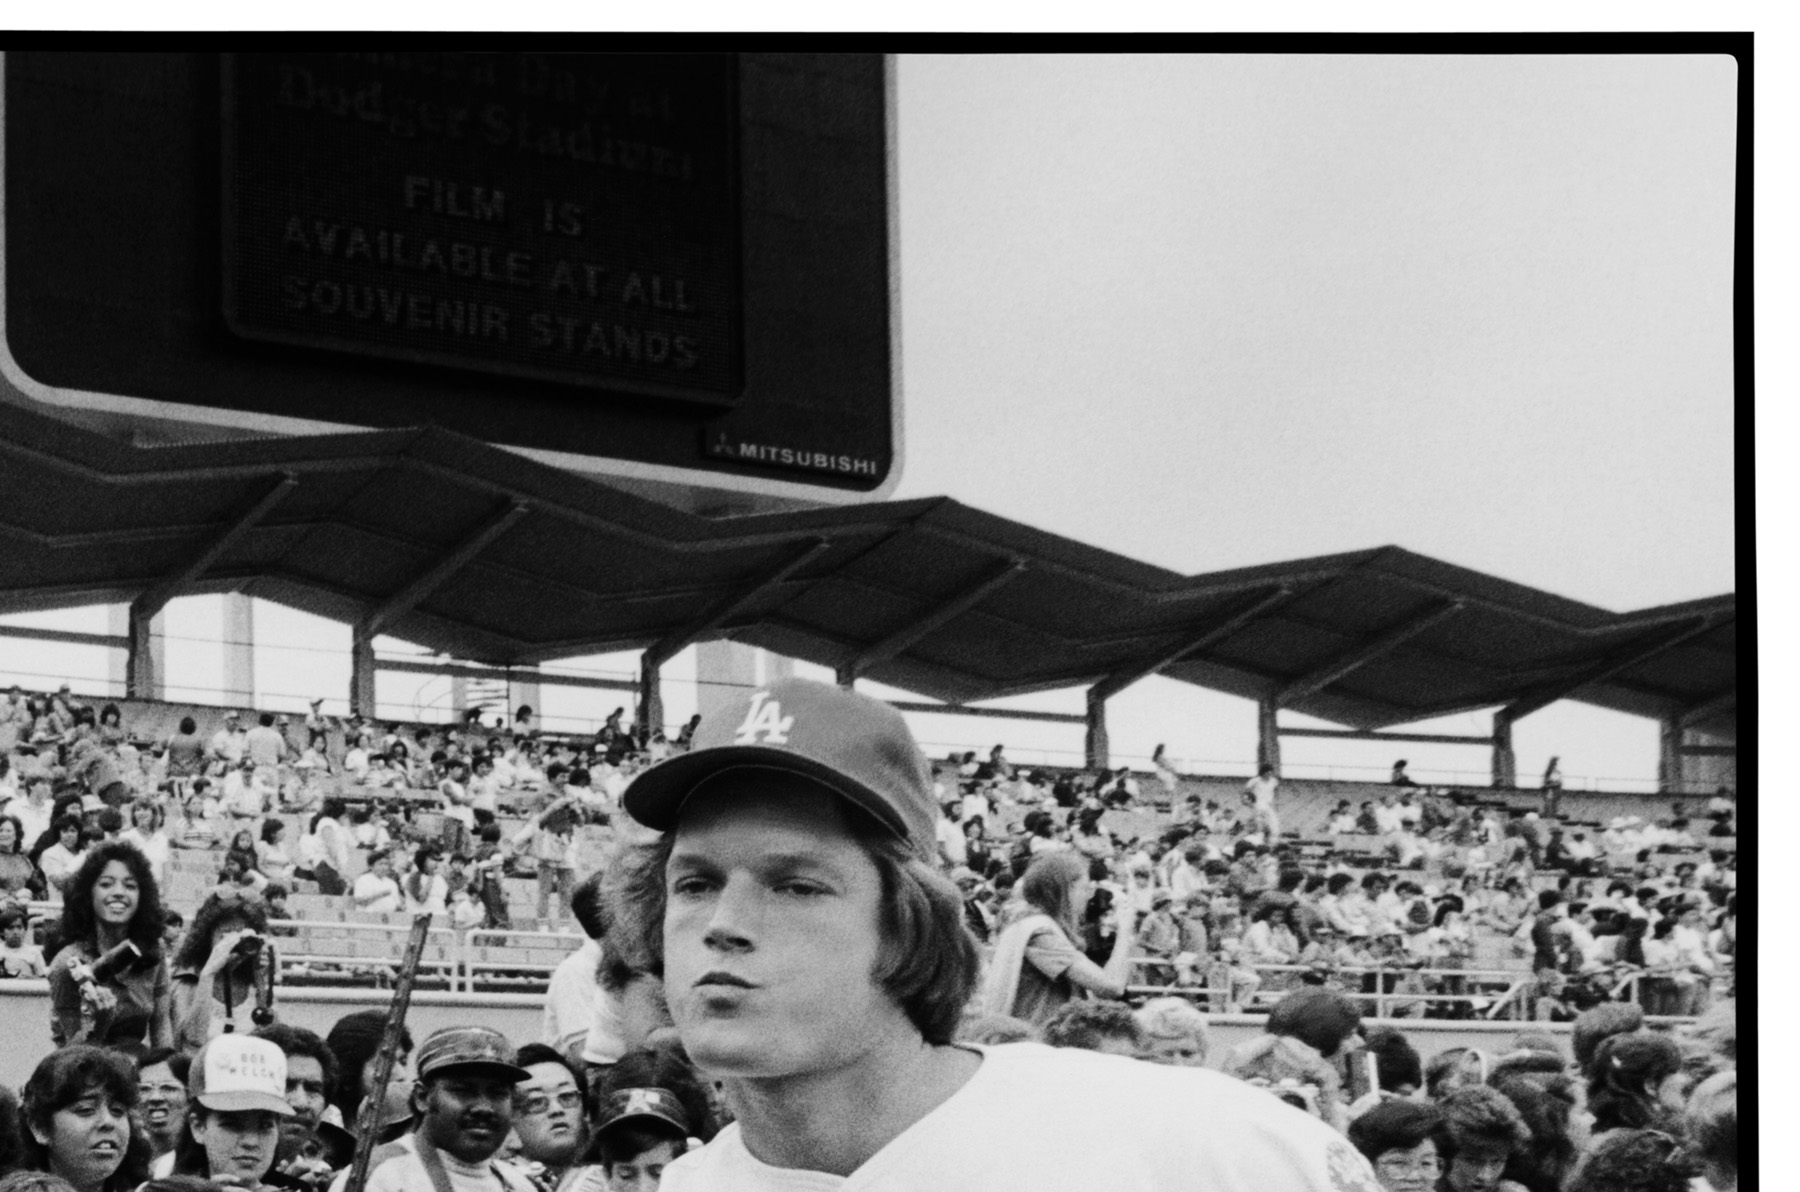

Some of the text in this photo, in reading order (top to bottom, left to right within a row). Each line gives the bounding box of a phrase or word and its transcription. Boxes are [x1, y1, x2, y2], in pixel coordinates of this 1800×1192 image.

[403, 174, 584, 237] FILM IS
[282, 214, 698, 312] AVAILABLE AT ALL
[281, 275, 701, 368] SOUVENIR STANDS
[739, 442, 877, 475] MITSUBISHI
[734, 691, 794, 744] LA
